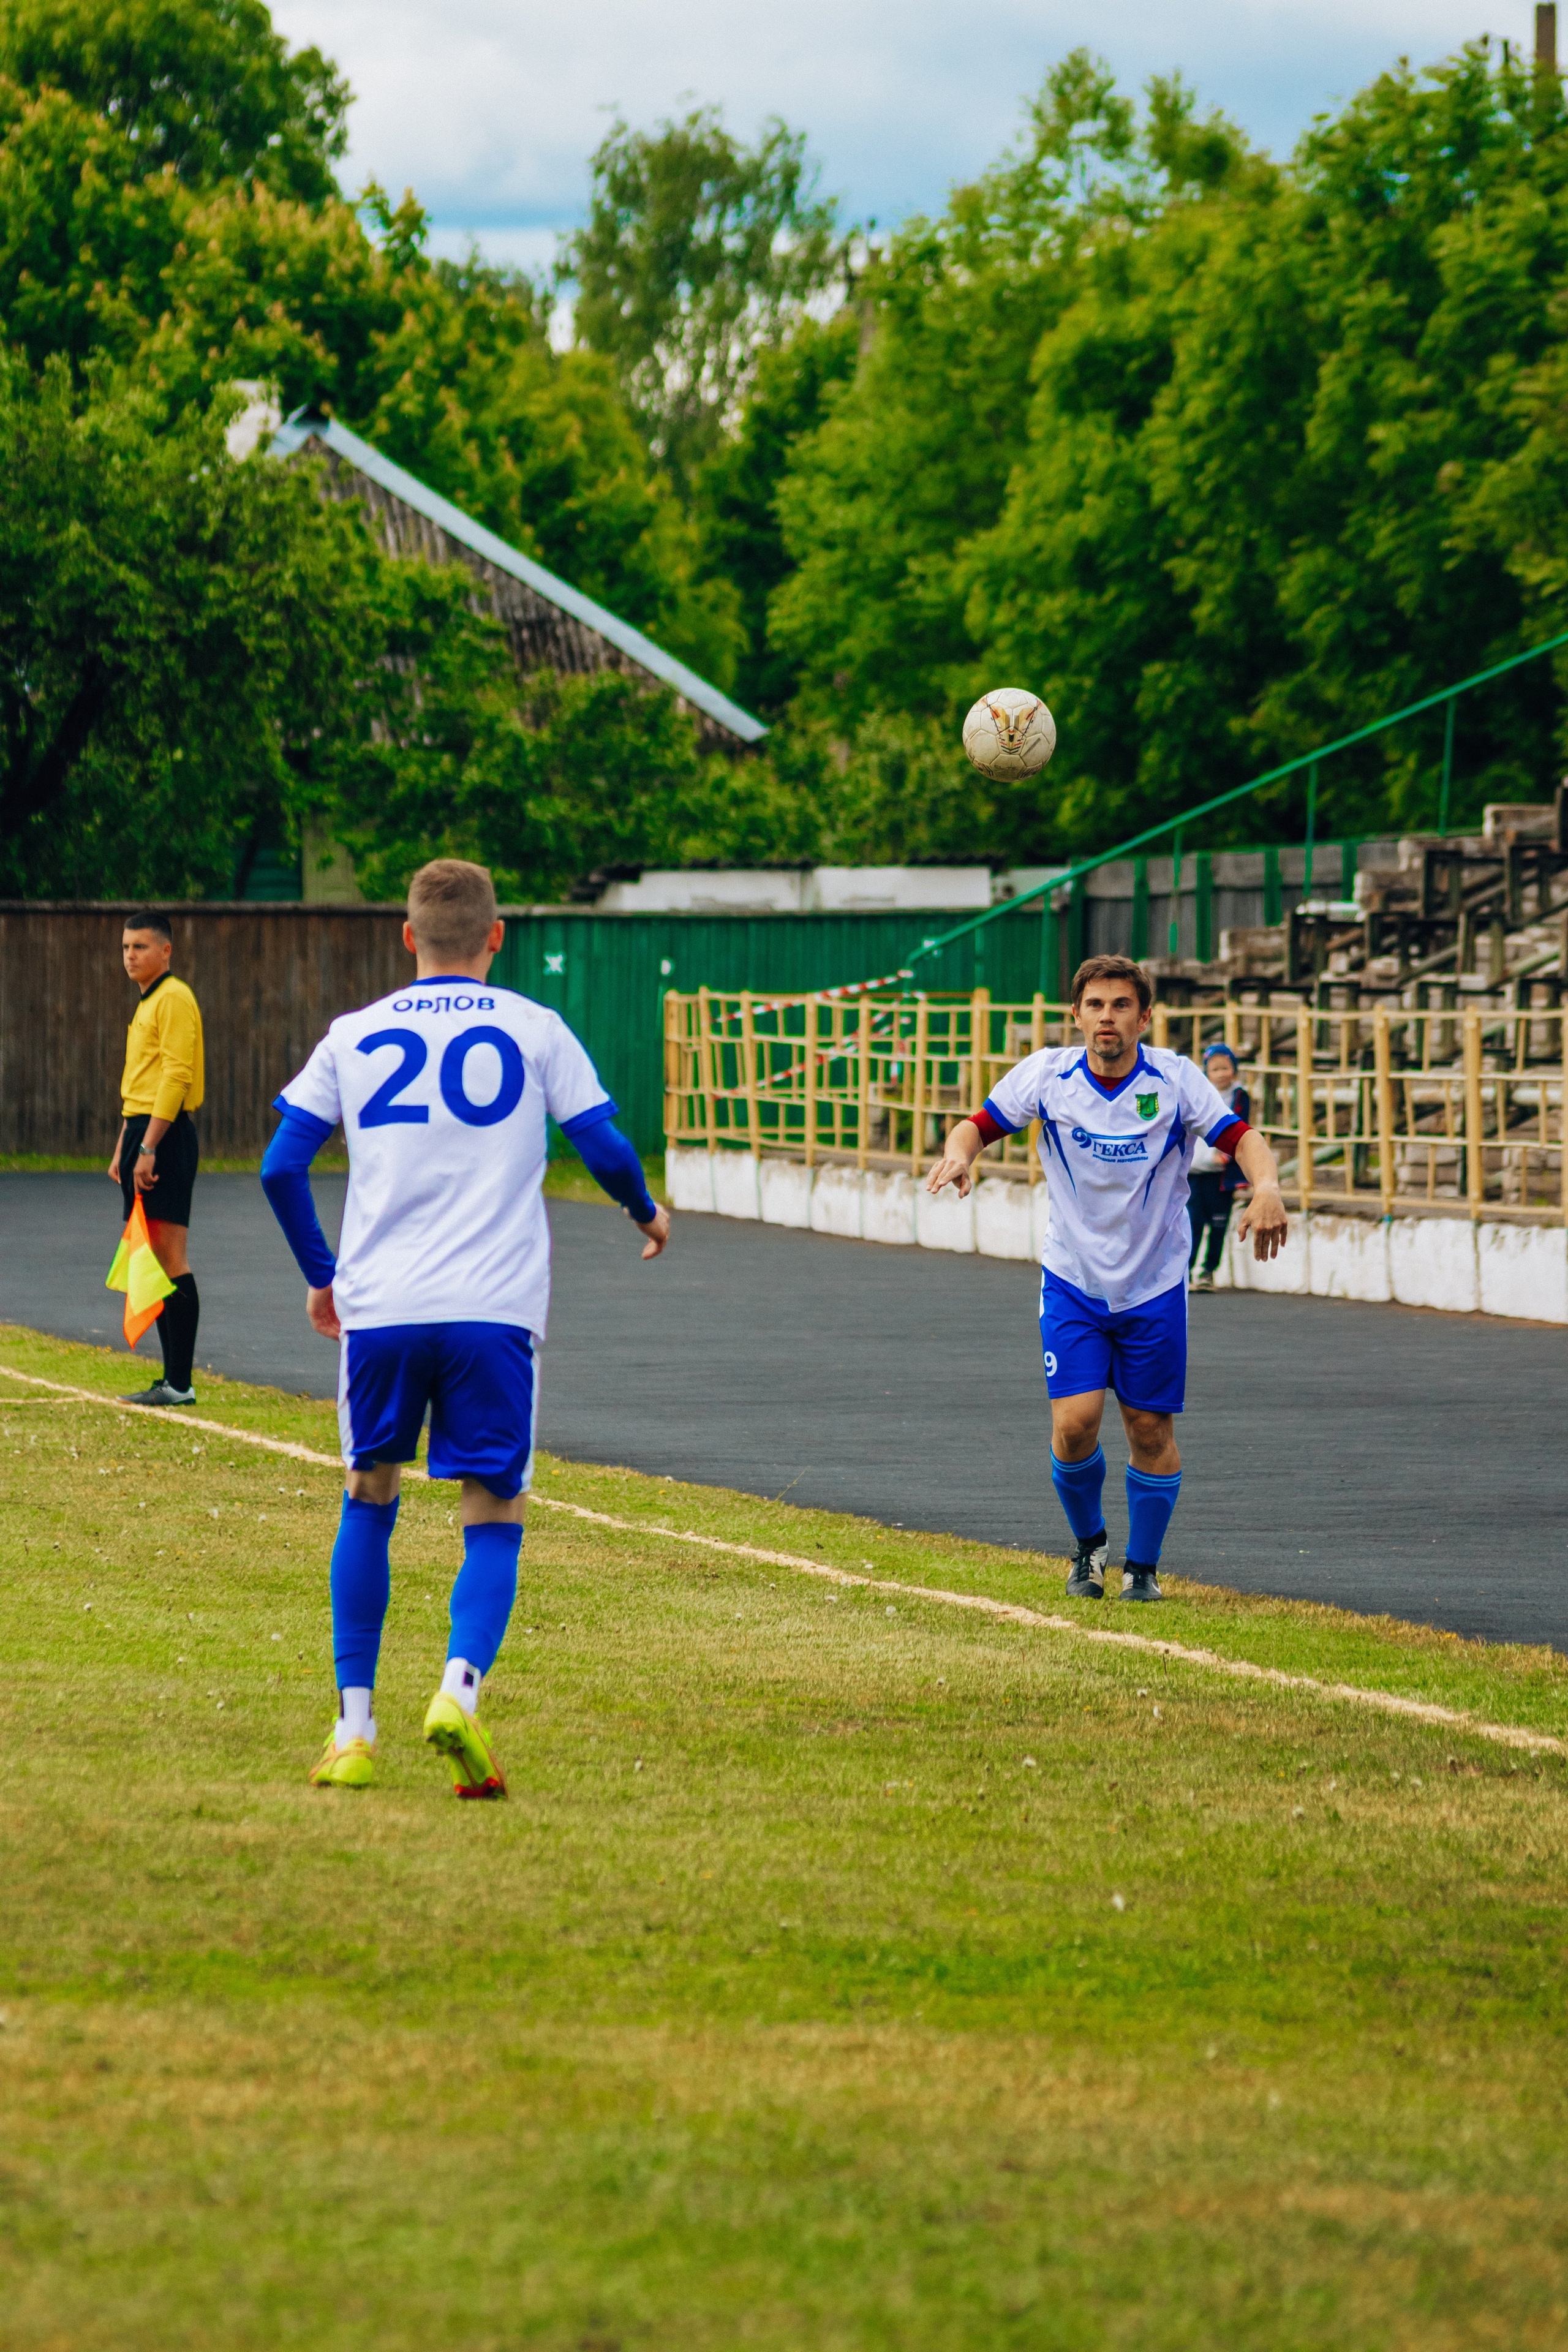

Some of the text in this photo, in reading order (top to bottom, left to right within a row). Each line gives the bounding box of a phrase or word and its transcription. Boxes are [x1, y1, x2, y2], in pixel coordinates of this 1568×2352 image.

[393, 996, 495, 1013] ОРЛОВ
[355, 1025, 525, 1129] 20
[1093, 1141, 1148, 1156] ГЕКСА
[1044, 1351, 1057, 1377] 9
